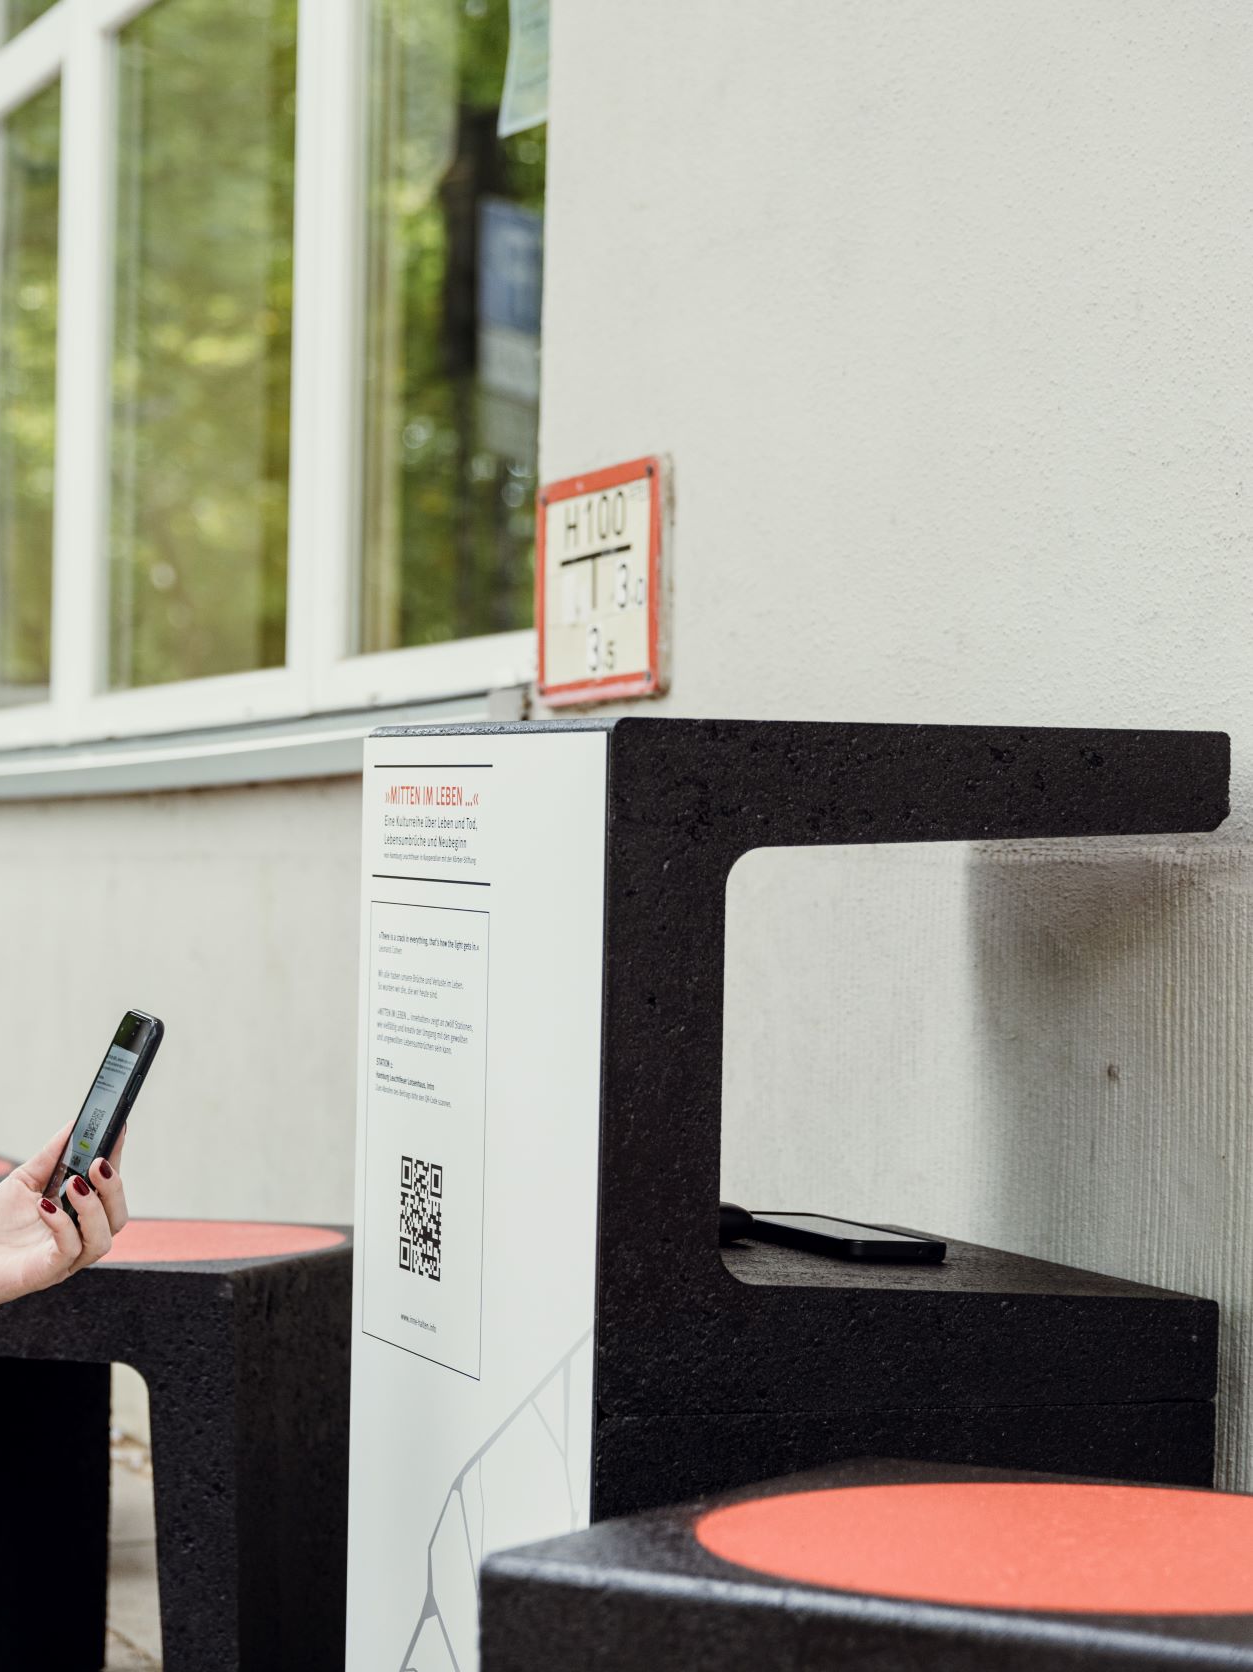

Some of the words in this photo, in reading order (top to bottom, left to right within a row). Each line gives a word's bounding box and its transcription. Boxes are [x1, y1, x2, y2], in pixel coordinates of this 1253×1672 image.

[385, 786, 421, 805] »MITTEN
[423, 787, 434, 805] IM
[436, 787, 463, 806] LEBEN
[384, 815, 395, 827] Eine
[396, 816, 424, 828] Kulturreihe
[425, 817, 437, 828] über
[438, 817, 454, 829] Leben
[455, 818, 465, 830] und
[466, 818, 478, 832] Tod,
[384, 834, 426, 847] Lebensumbrüche
[428, 836, 437, 847] und
[439, 836, 467, 852] Neubeginn
